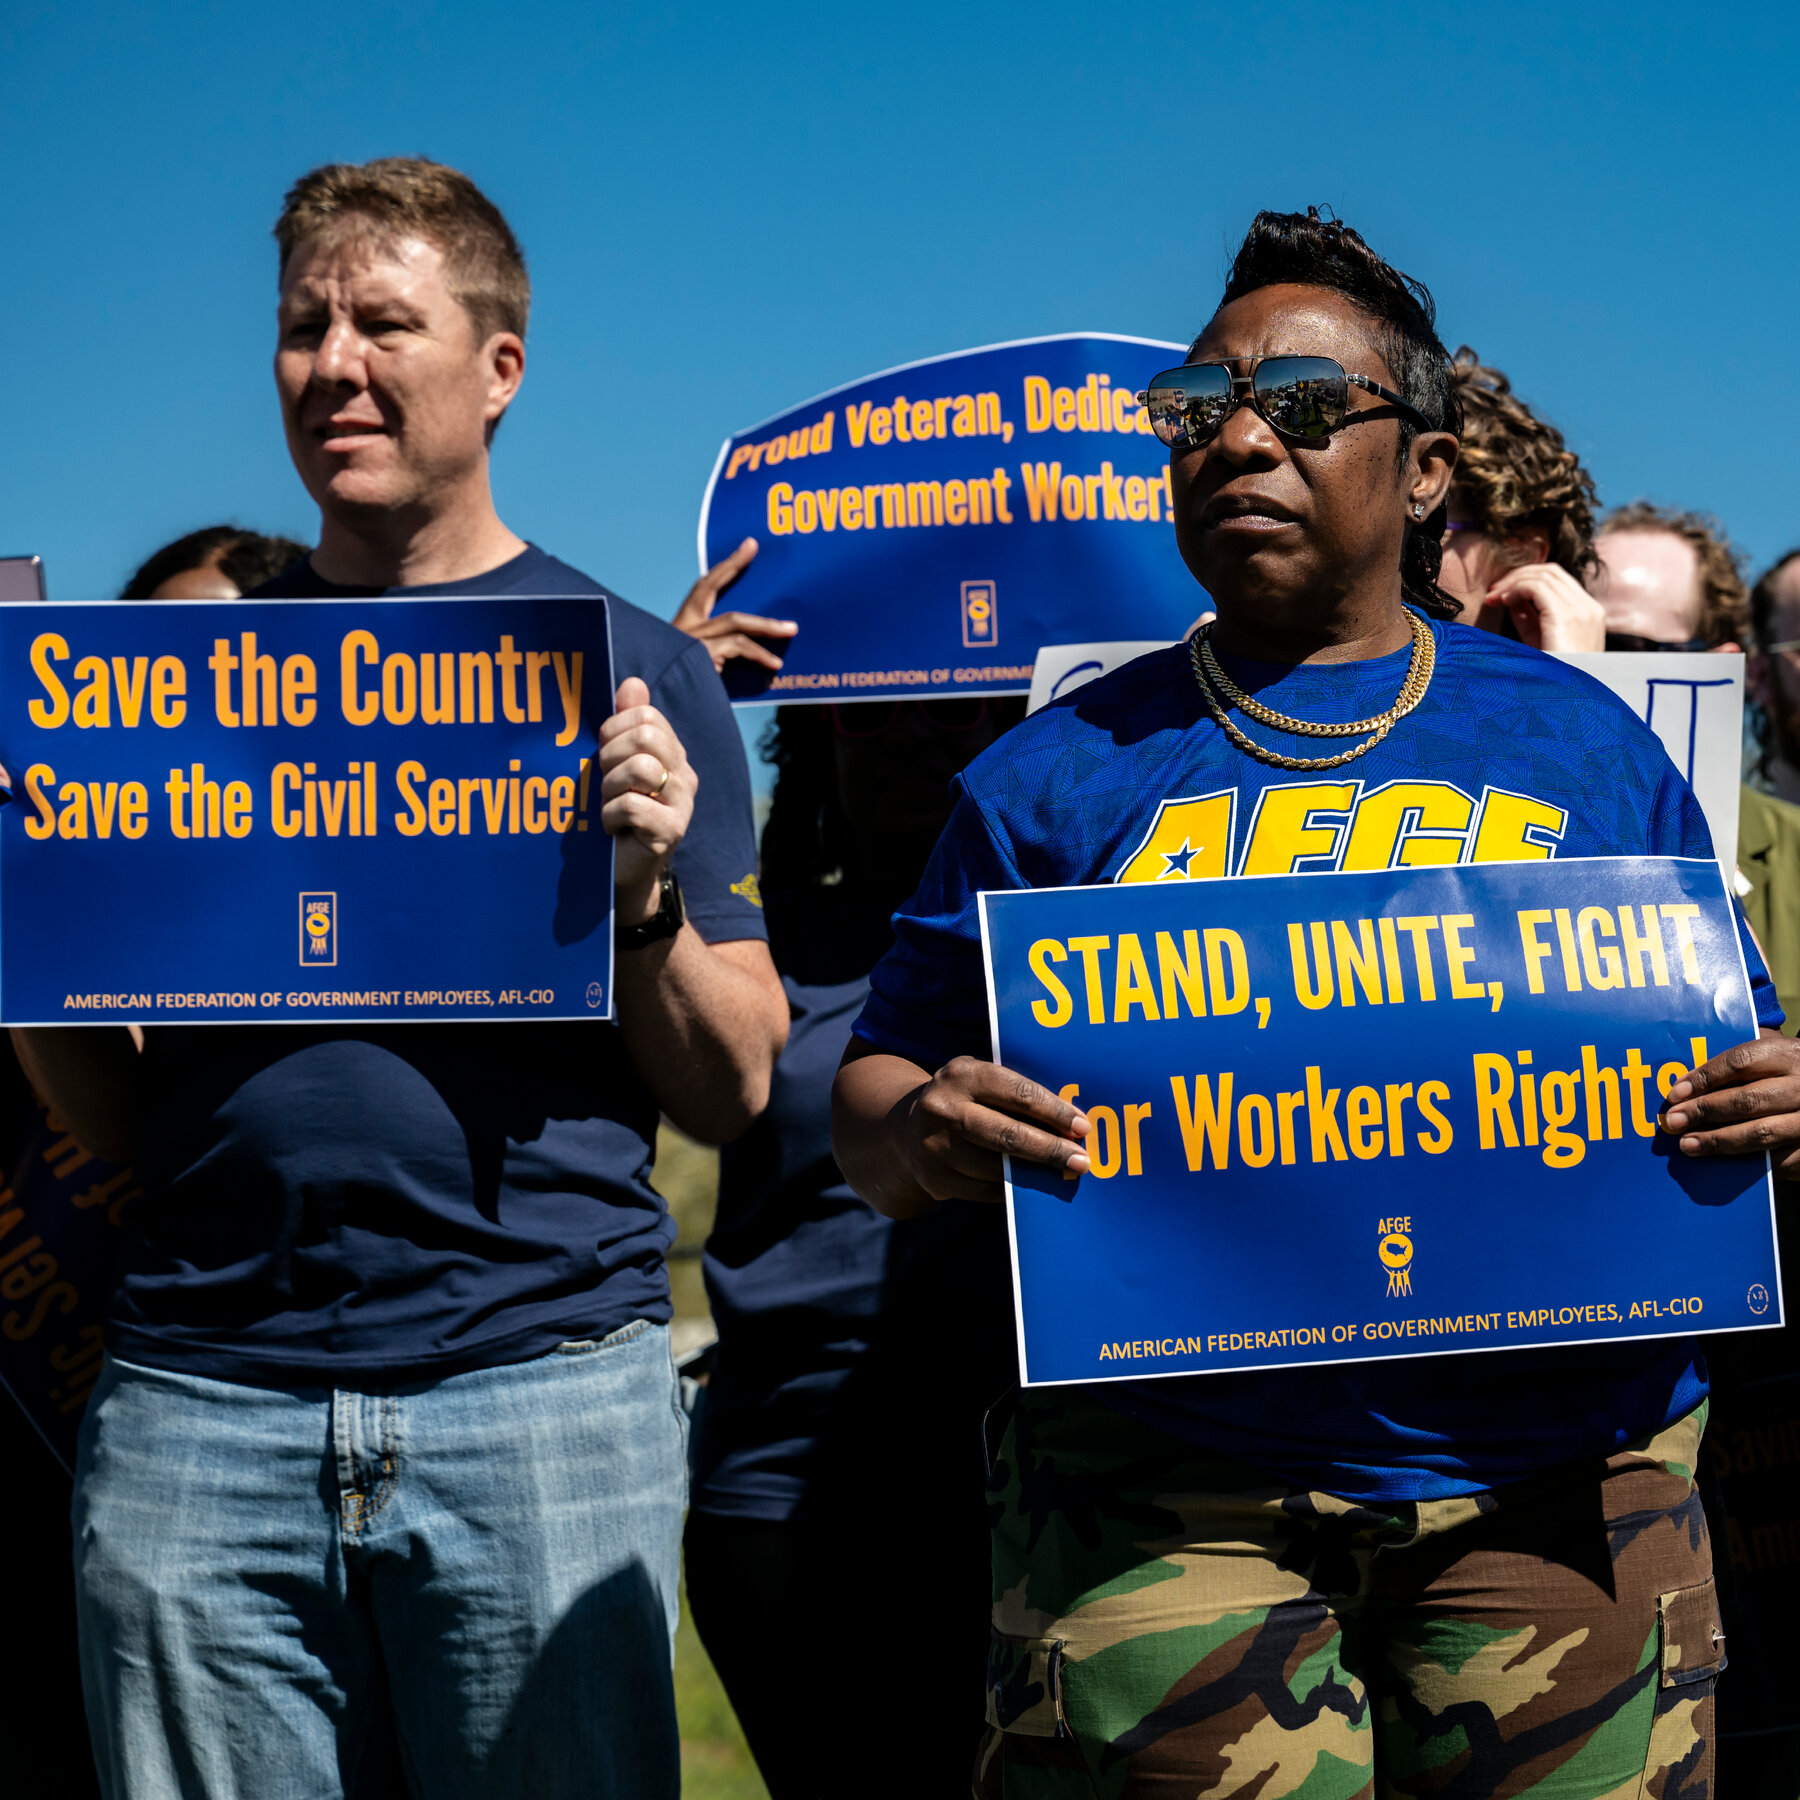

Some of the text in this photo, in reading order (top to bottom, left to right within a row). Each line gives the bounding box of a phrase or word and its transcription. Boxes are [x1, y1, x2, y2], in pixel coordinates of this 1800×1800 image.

[725, 411, 835, 479] Proud
[845, 391, 1015, 444] Veteran,
[766, 461, 1175, 536] Government Worker!
[27, 629, 584, 747] Save the Country
[841, 670, 929, 687] FEDERATION
[930, 669, 950, 684] OF
[23, 757, 592, 841] Save the Civil Service!
[306, 902, 330, 914] AFGE
[63, 988, 555, 1009] AMERICAN FEDERATION OF GOVERNMENT EMPLOYEES, AFL-CIO
[1028, 903, 1702, 1030] STAND, UNITE, FIGHT
[1169, 1065, 1454, 1173] Workers
[1377, 1215, 1412, 1235] AFGE
[1099, 1296, 1703, 1361] AMERICAN FEDERATION OF GOVERNMENT EMPLOYEES, AFL-CIO
